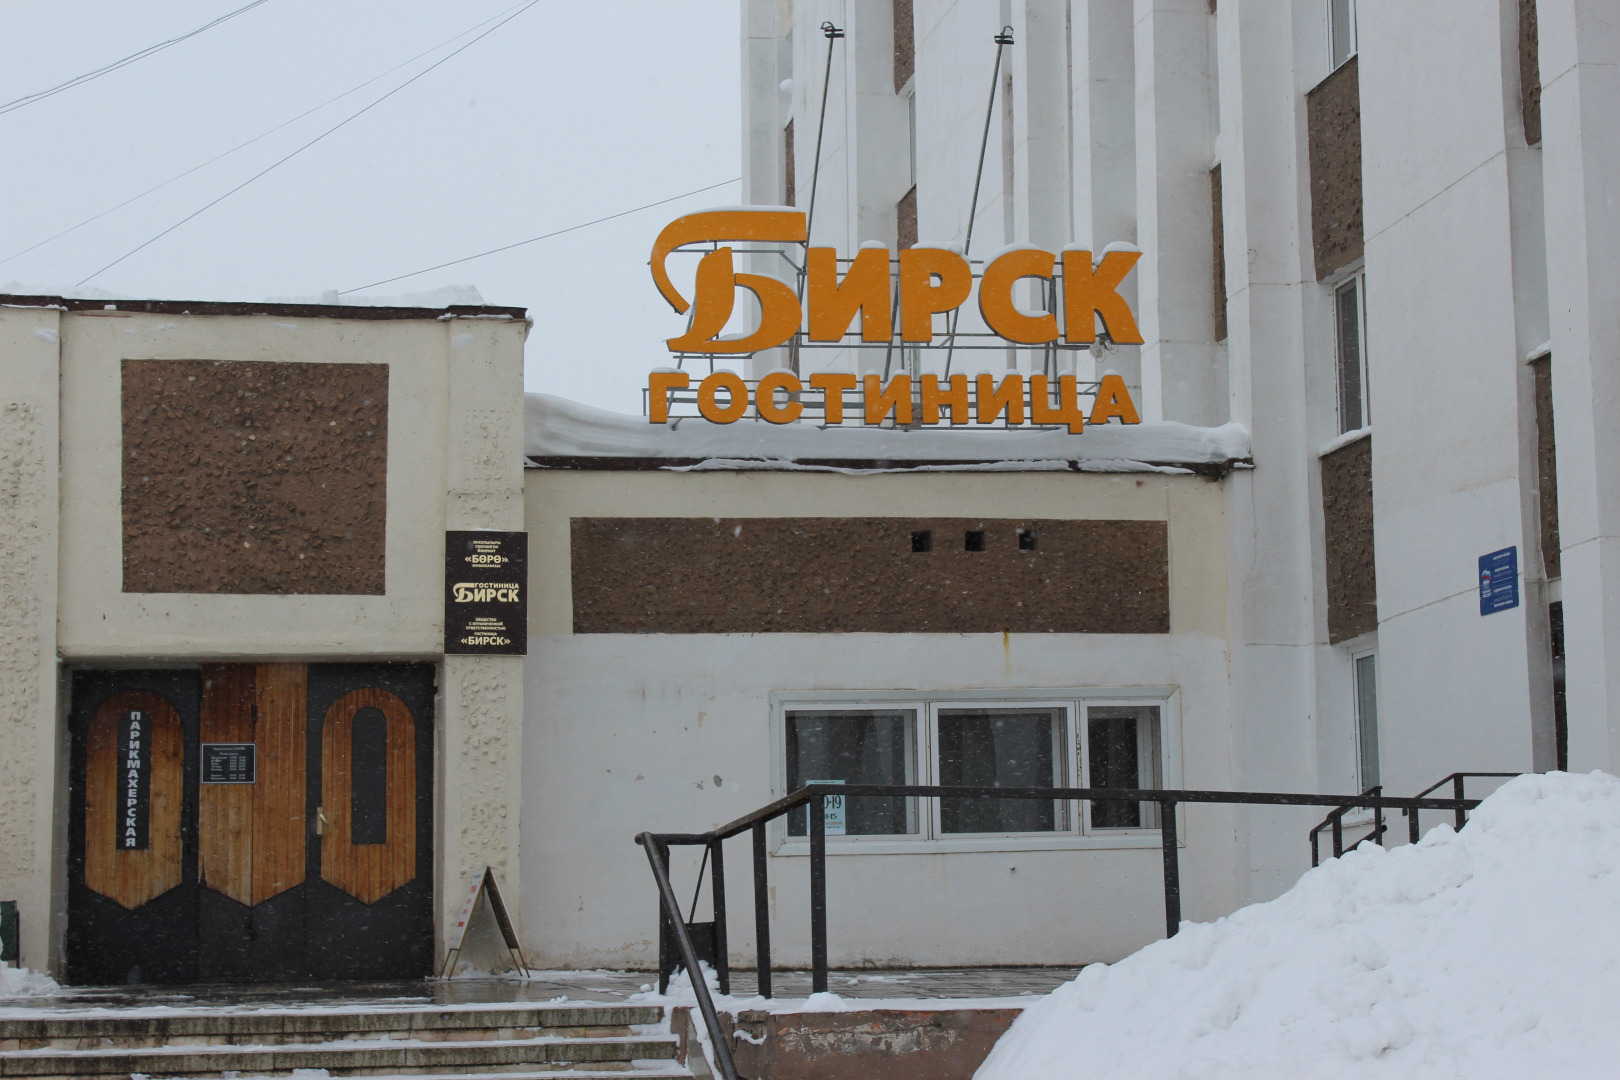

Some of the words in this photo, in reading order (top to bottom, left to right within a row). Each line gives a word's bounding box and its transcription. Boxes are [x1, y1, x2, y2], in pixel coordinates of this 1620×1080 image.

[650, 209, 1145, 353] БИРСК
[648, 371, 1141, 435] ГОСТИНИЦА
[453, 582, 520, 602] БИРСК
[461, 636, 511, 645] «БИРСК»
[125, 711, 141, 847] ПАРИКМАХЕРСКАЯ
